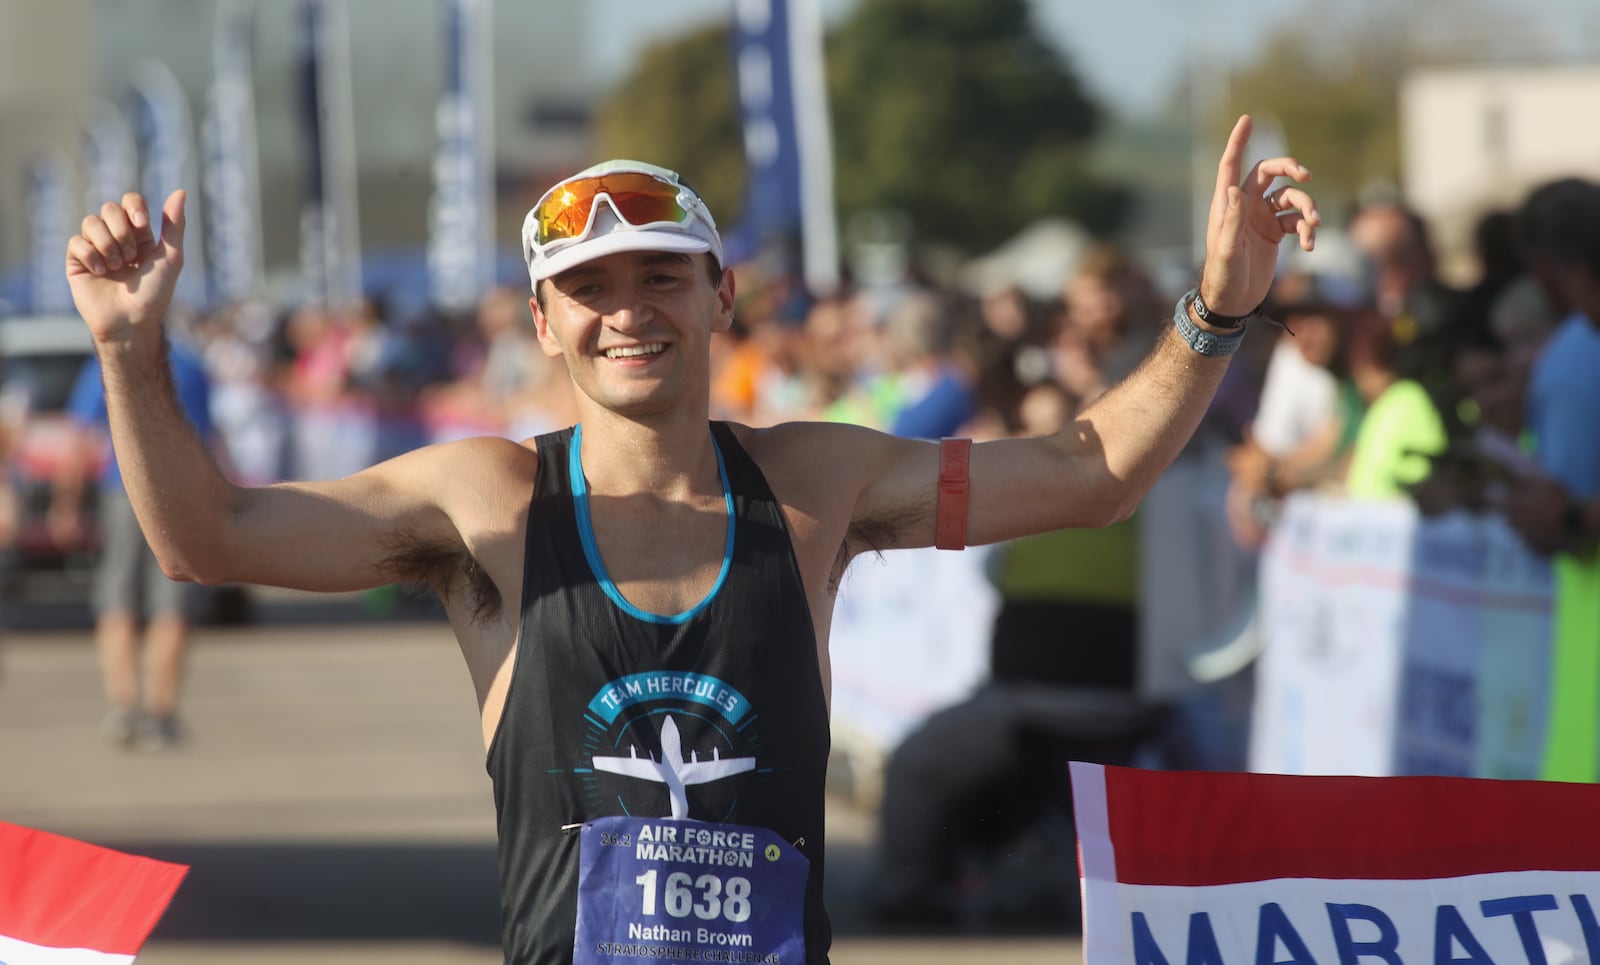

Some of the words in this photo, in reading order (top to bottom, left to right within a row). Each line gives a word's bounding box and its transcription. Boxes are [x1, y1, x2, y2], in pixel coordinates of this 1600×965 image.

[601, 679, 643, 710] TEAM
[647, 676, 738, 713] HERCULES
[600, 831, 631, 847] 26.2
[637, 824, 677, 844] AIR
[684, 827, 755, 850] FORCE
[636, 843, 754, 868] MARATHON
[635, 869, 752, 923] 1638
[628, 923, 691, 943] Nathan
[697, 928, 753, 947] Brown
[597, 943, 699, 961] STRATOSPHERE
[703, 951, 780, 965] CHALLENGE
